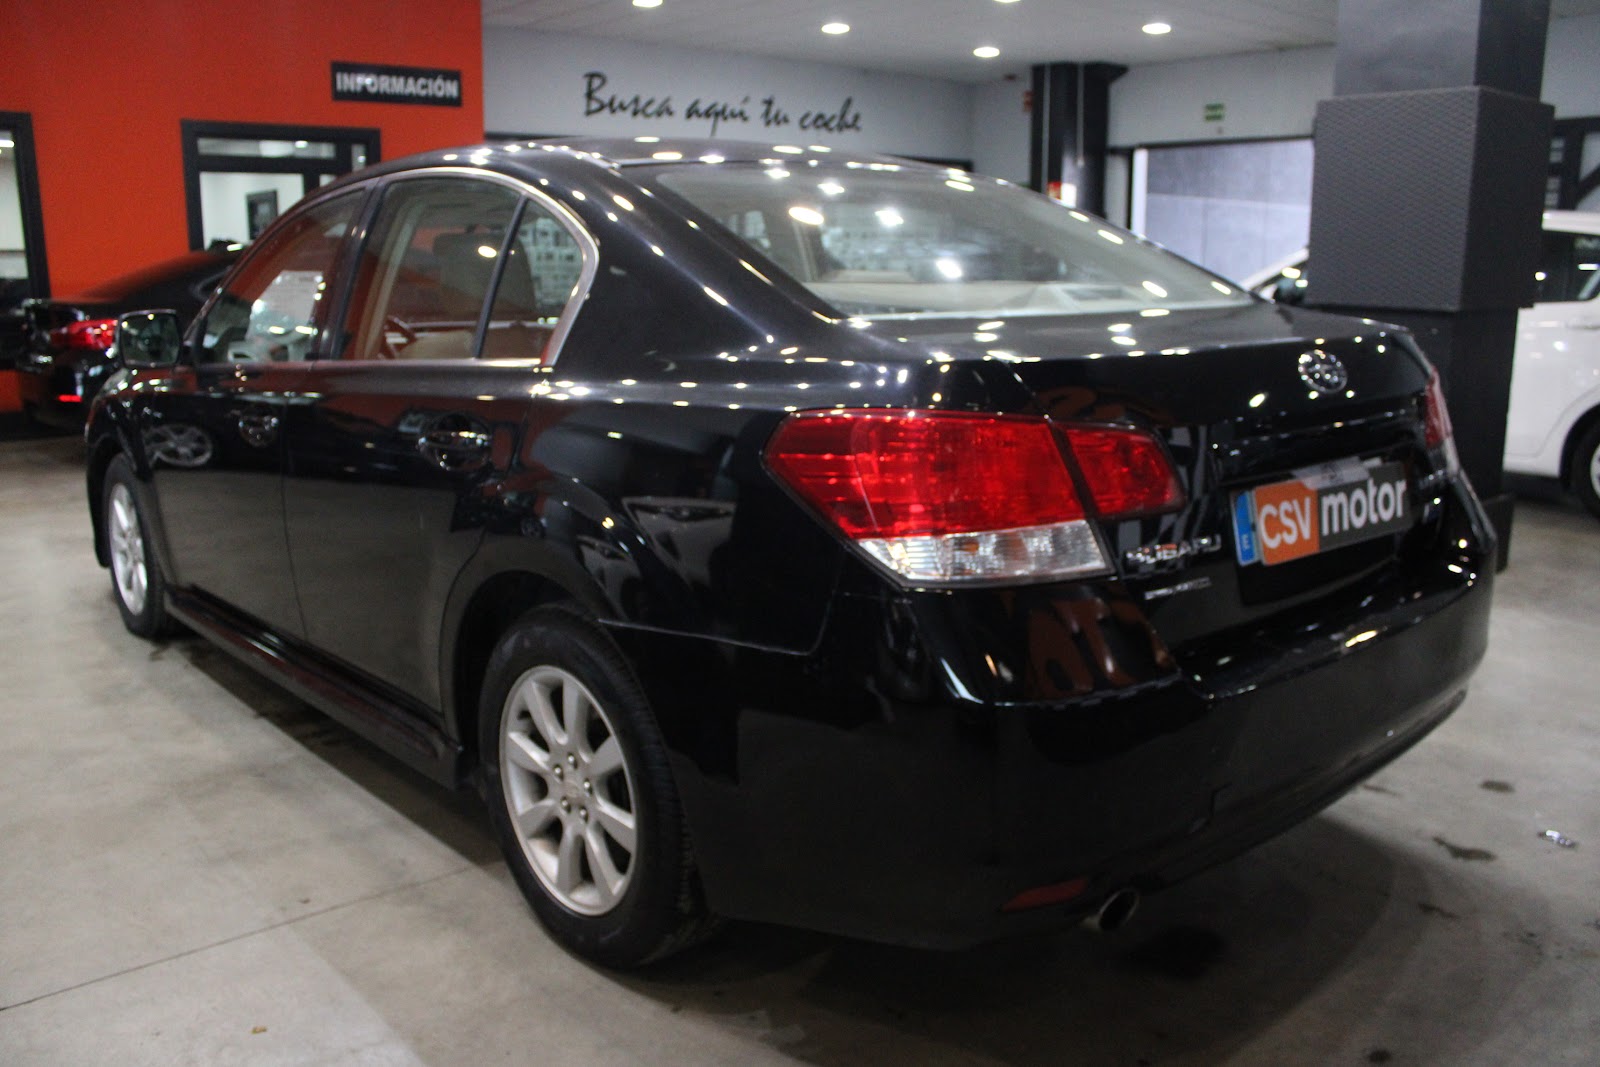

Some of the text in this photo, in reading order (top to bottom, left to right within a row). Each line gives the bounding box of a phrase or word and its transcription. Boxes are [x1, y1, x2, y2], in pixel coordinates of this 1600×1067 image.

[336, 71, 459, 99] INFORMACIÓN
[583, 71, 863, 137] Busca aquí tu coche
[1259, 477, 1408, 549] CSV motor
